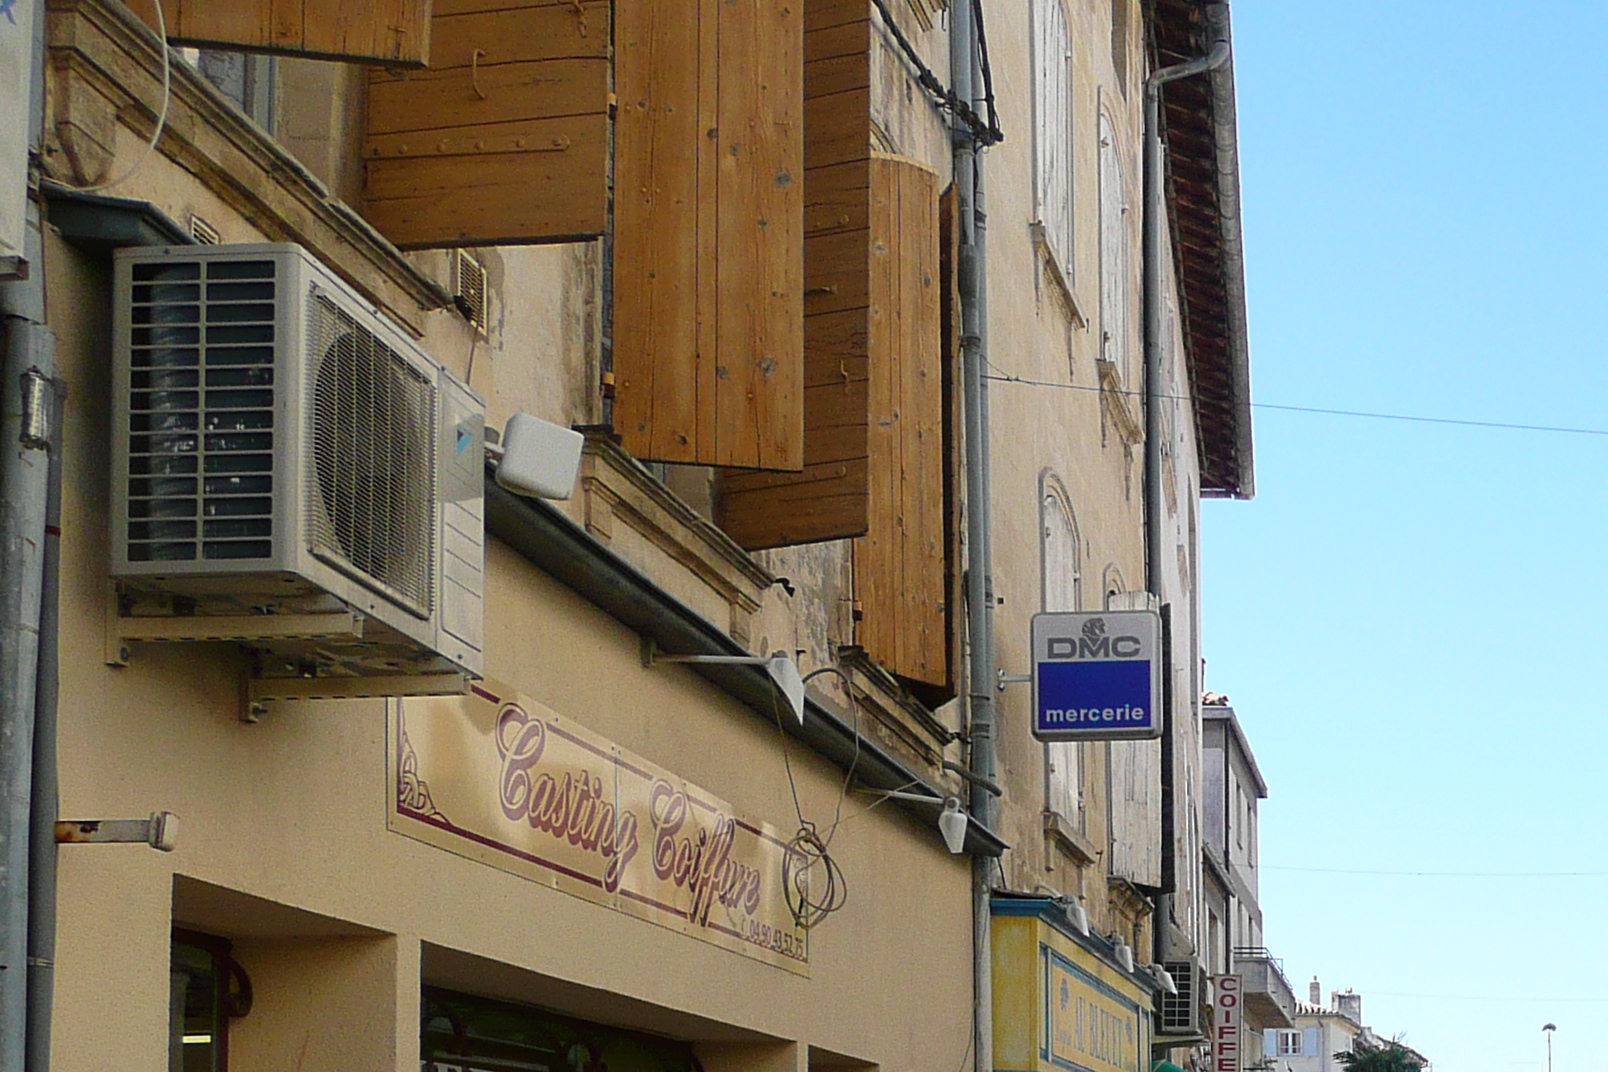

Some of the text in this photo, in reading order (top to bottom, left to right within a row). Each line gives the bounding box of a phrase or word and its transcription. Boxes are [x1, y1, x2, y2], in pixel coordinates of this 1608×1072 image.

[1047, 636, 1141, 659] DMC
[1046, 704, 1144, 722] mercerie
[495, 702, 761, 927] Casting Coiffure
